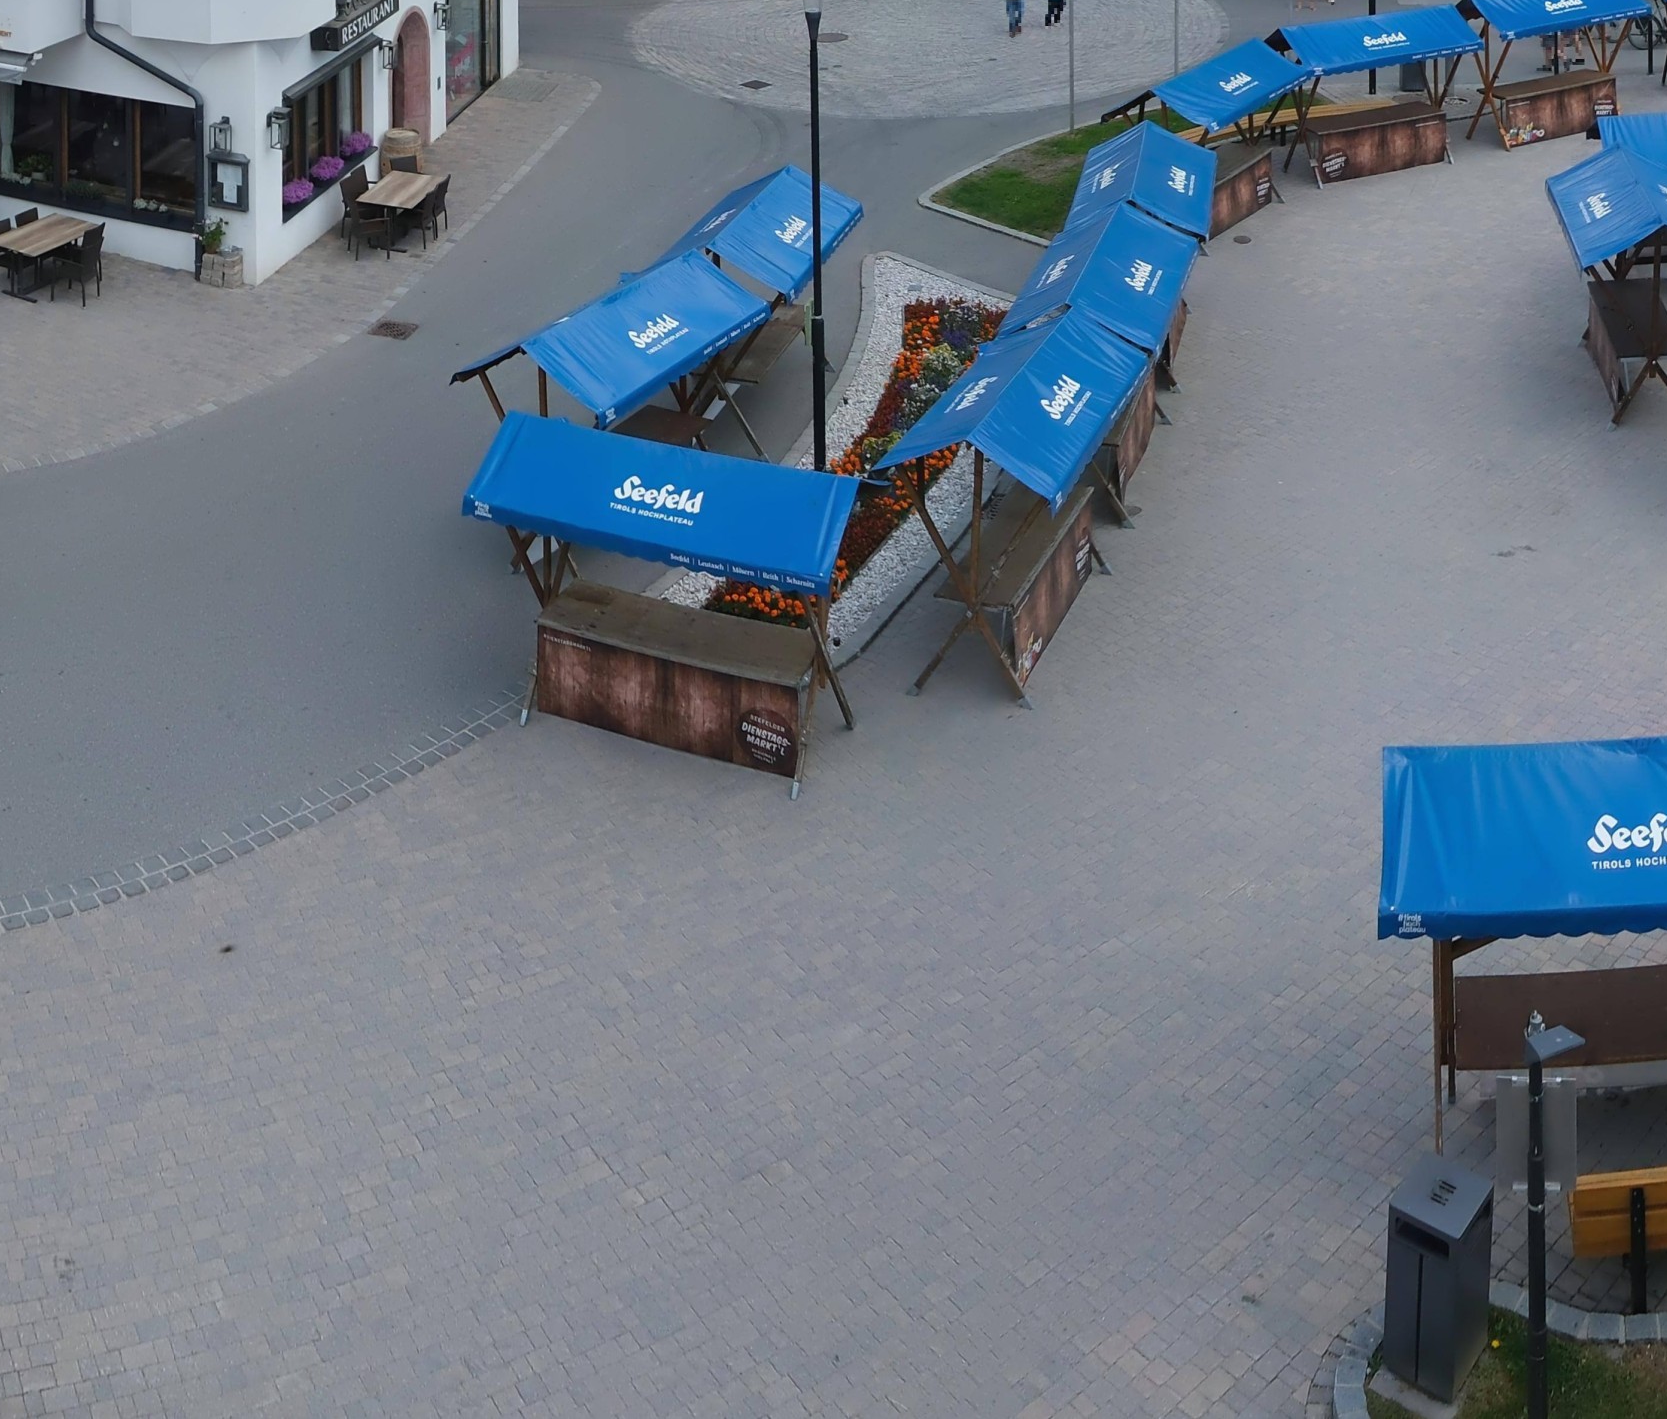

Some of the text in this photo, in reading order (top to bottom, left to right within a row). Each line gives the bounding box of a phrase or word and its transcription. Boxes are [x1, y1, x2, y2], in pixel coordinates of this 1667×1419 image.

[1363, 31, 1407, 47] Seefeld
[1219, 71, 1252, 93] Seefeld
[1586, 192, 1614, 220] Seefeld
[774, 214, 807, 244] Seefeld
[1124, 259, 1153, 292] Seefeld
[628, 313, 680, 349] Seefeld
[1040, 374, 1081, 420] Seefeld
[613, 475, 704, 515] Seefeld
[609, 501, 694, 526] TIROLS HOCHPLATEAU
[741, 721, 792, 747] DIENSTAGS-
[745, 733, 786, 756] MARKT'L
[1591, 858, 1632, 871] TIROLS
